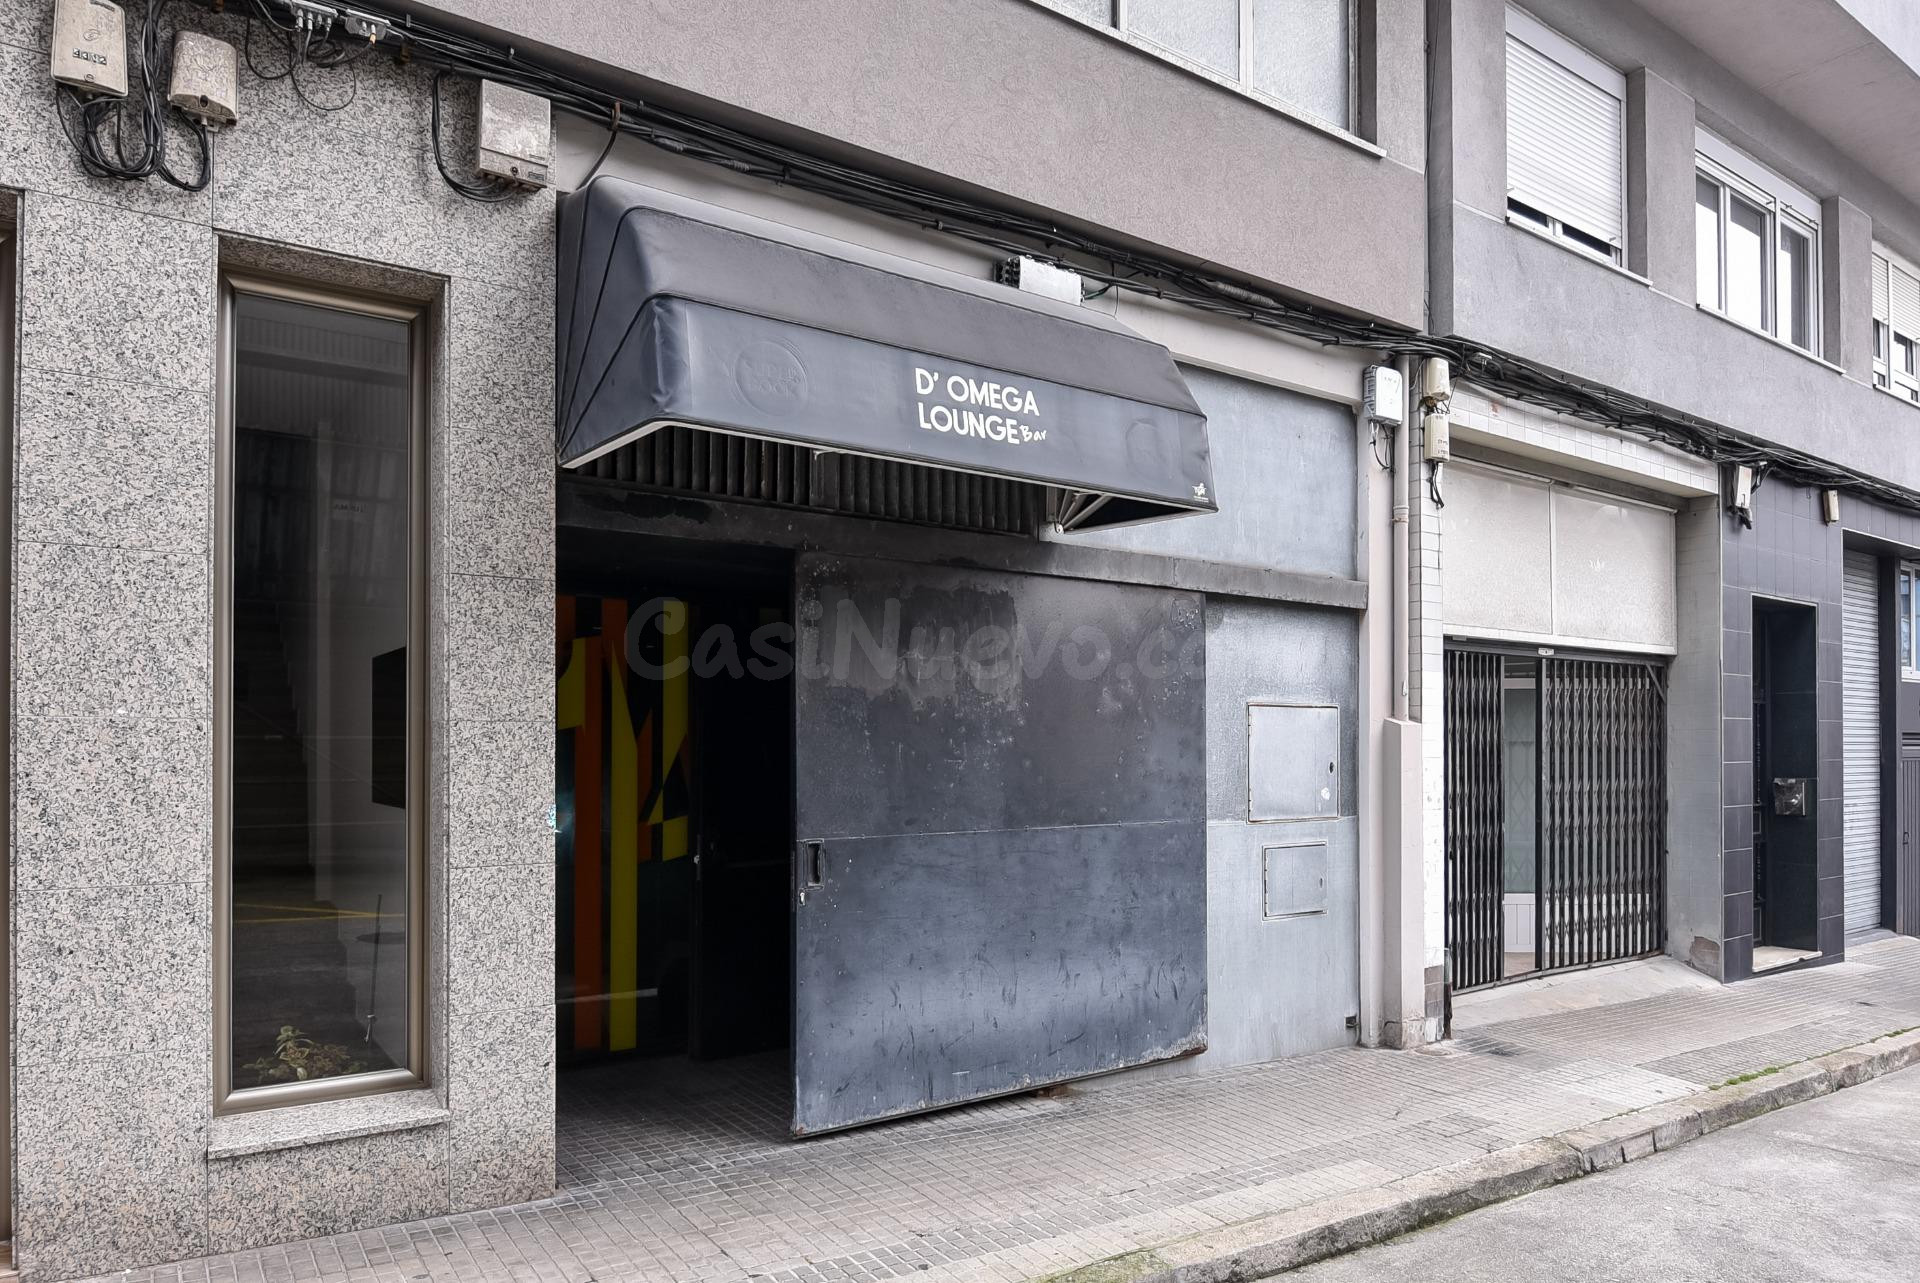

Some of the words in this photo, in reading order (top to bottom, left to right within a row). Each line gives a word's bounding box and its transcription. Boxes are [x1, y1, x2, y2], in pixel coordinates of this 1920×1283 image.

[915, 367, 939, 395] D'
[947, 375, 1040, 416] OMEGA
[918, 402, 1020, 444] LOUNGE
[1020, 425, 1047, 442] Bar
